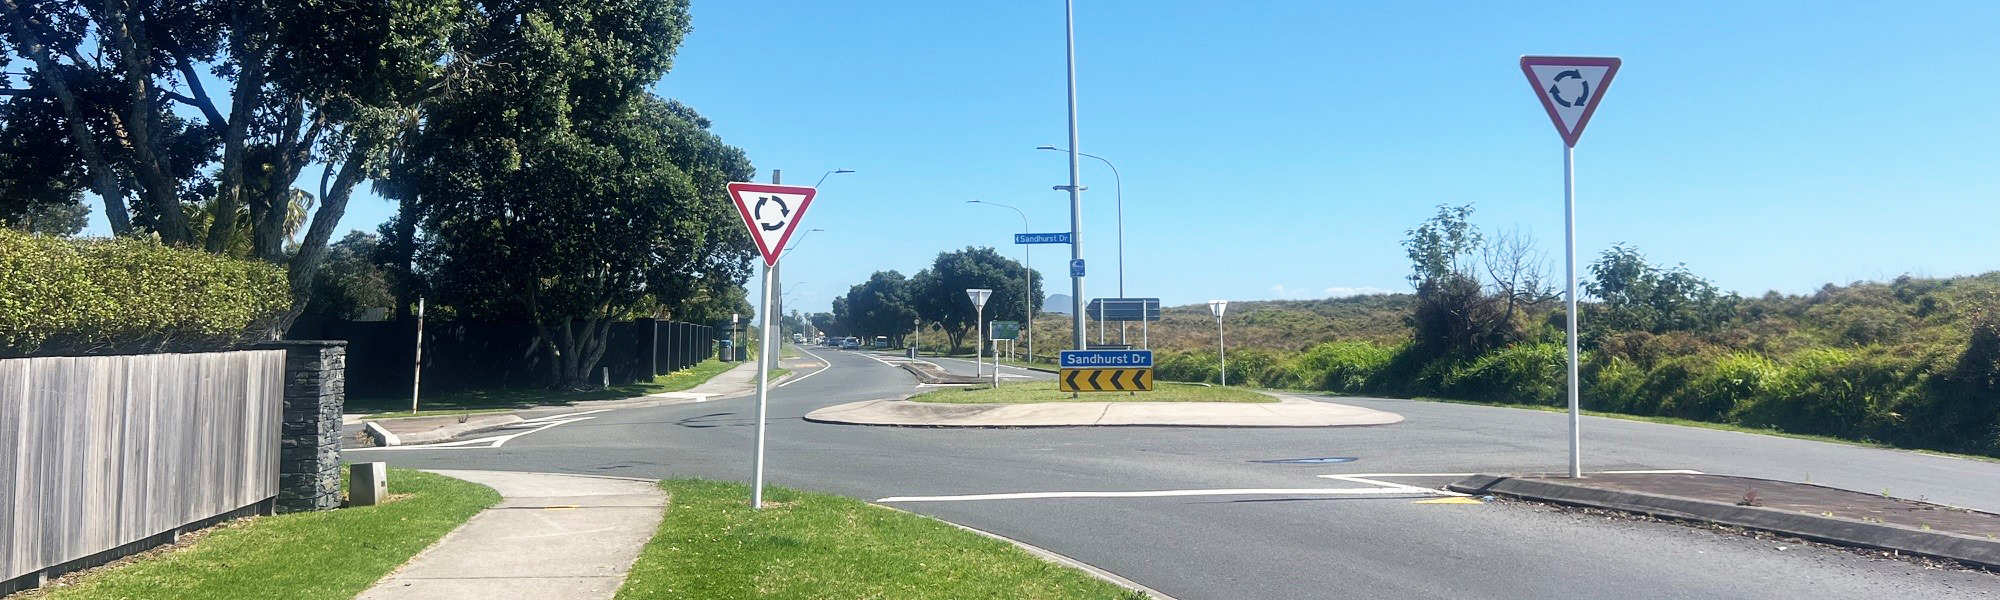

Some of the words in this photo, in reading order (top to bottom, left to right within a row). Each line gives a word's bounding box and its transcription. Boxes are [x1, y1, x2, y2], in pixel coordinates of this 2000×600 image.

[1020, 234, 1057, 243] Sandhurst
[1058, 234, 1068, 242] Dr
[1067, 353, 1128, 364] Sandhurst
[1132, 353, 1146, 364] Dr
